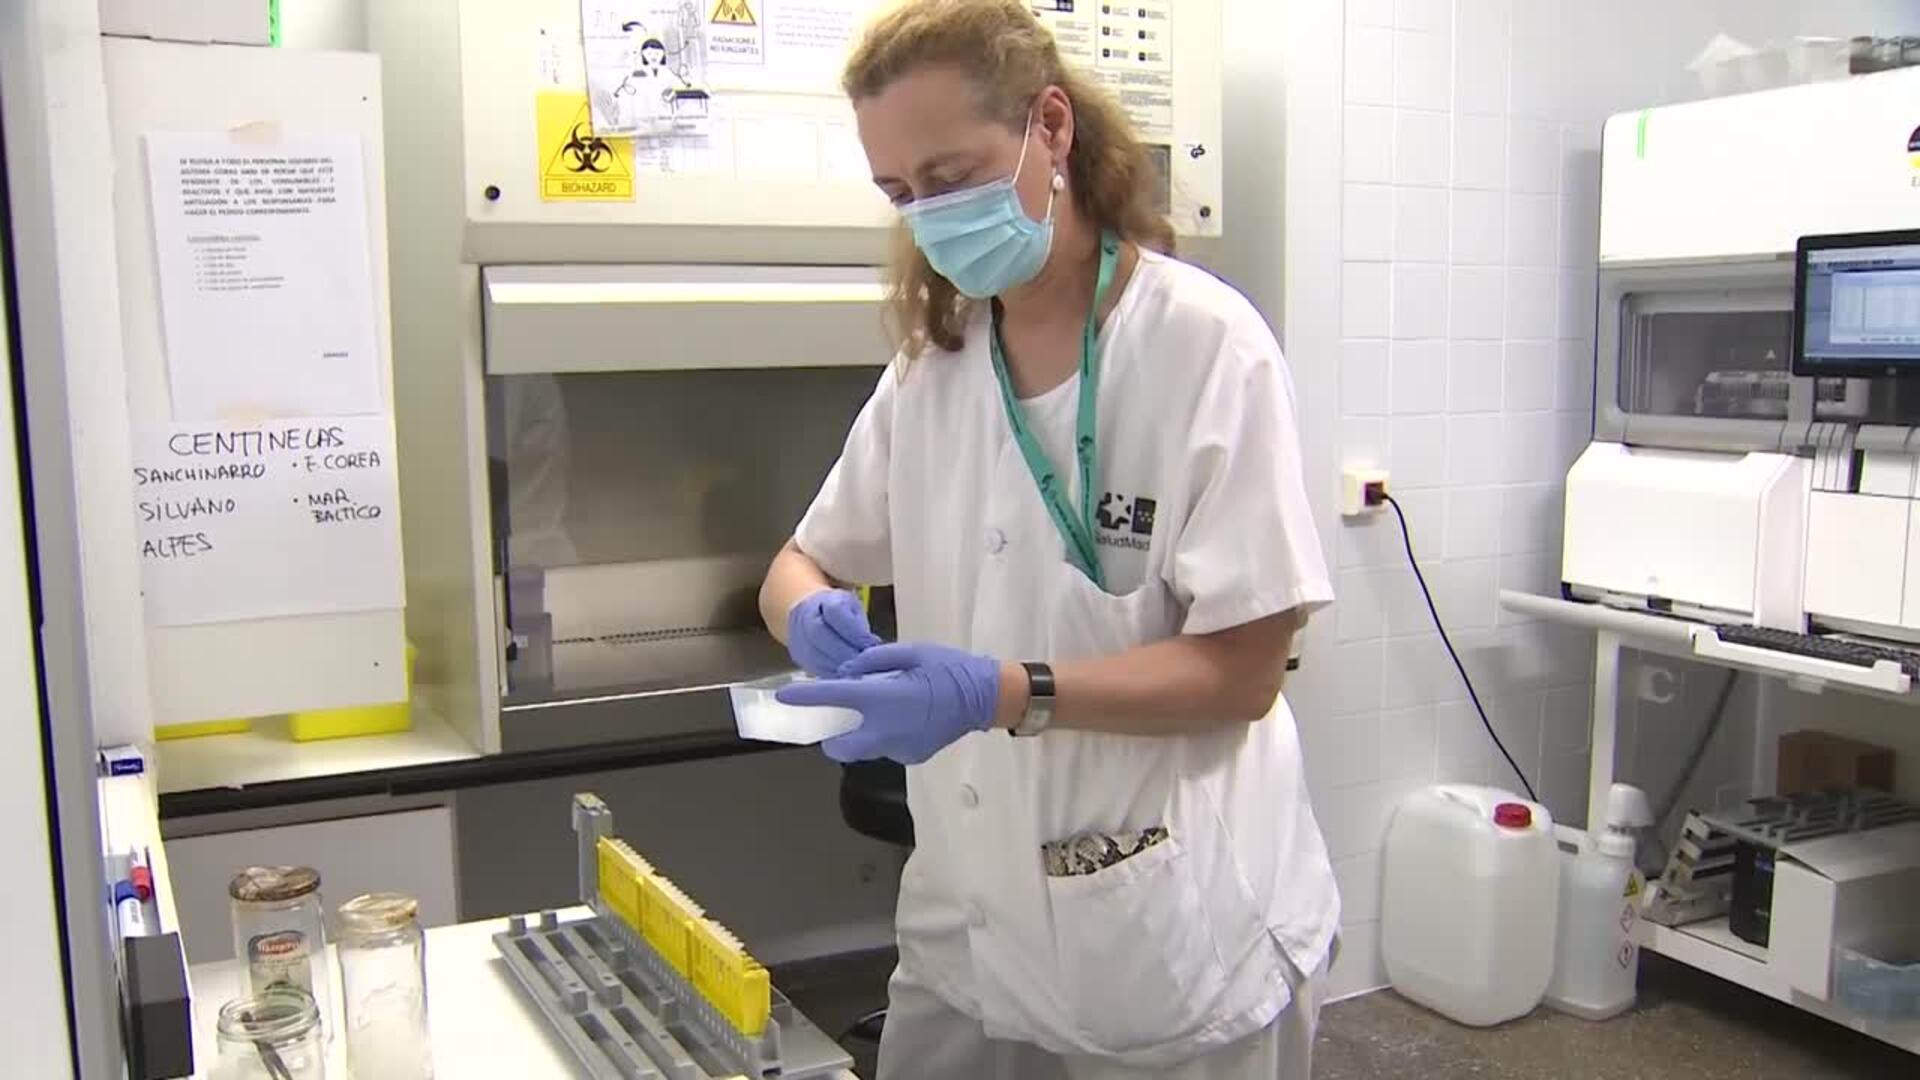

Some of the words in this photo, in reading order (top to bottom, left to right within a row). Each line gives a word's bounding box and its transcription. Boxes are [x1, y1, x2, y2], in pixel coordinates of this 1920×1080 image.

[561, 182, 616, 193] BIOHAZARD
[168, 426, 344, 457] CENTINELAS
[323, 451, 381, 470] COREA
[133, 463, 266, 485] SANCHINARRO
[139, 496, 236, 521] SILVANO
[308, 488, 350, 507] MAR
[142, 532, 213, 559] ALPES
